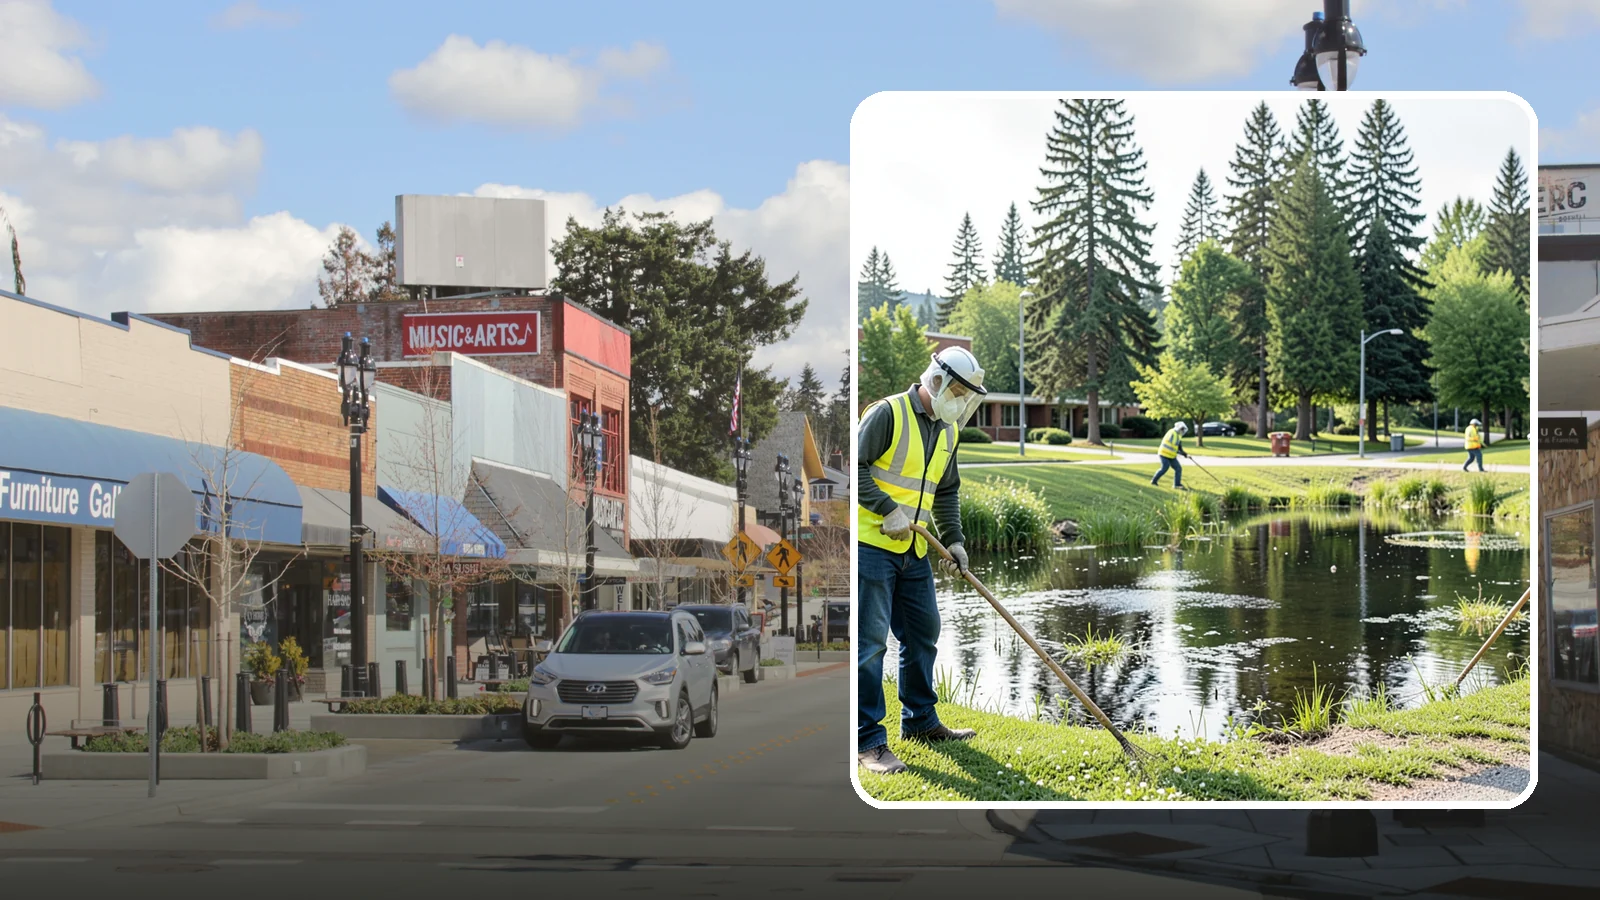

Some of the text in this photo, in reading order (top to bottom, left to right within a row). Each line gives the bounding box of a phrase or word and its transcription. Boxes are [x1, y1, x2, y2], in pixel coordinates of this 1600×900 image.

[1540, 427, 1577, 437] UGA
[0, 471, 121, 519] Furniture Gal
[453, 563, 479, 574] SUSHI
